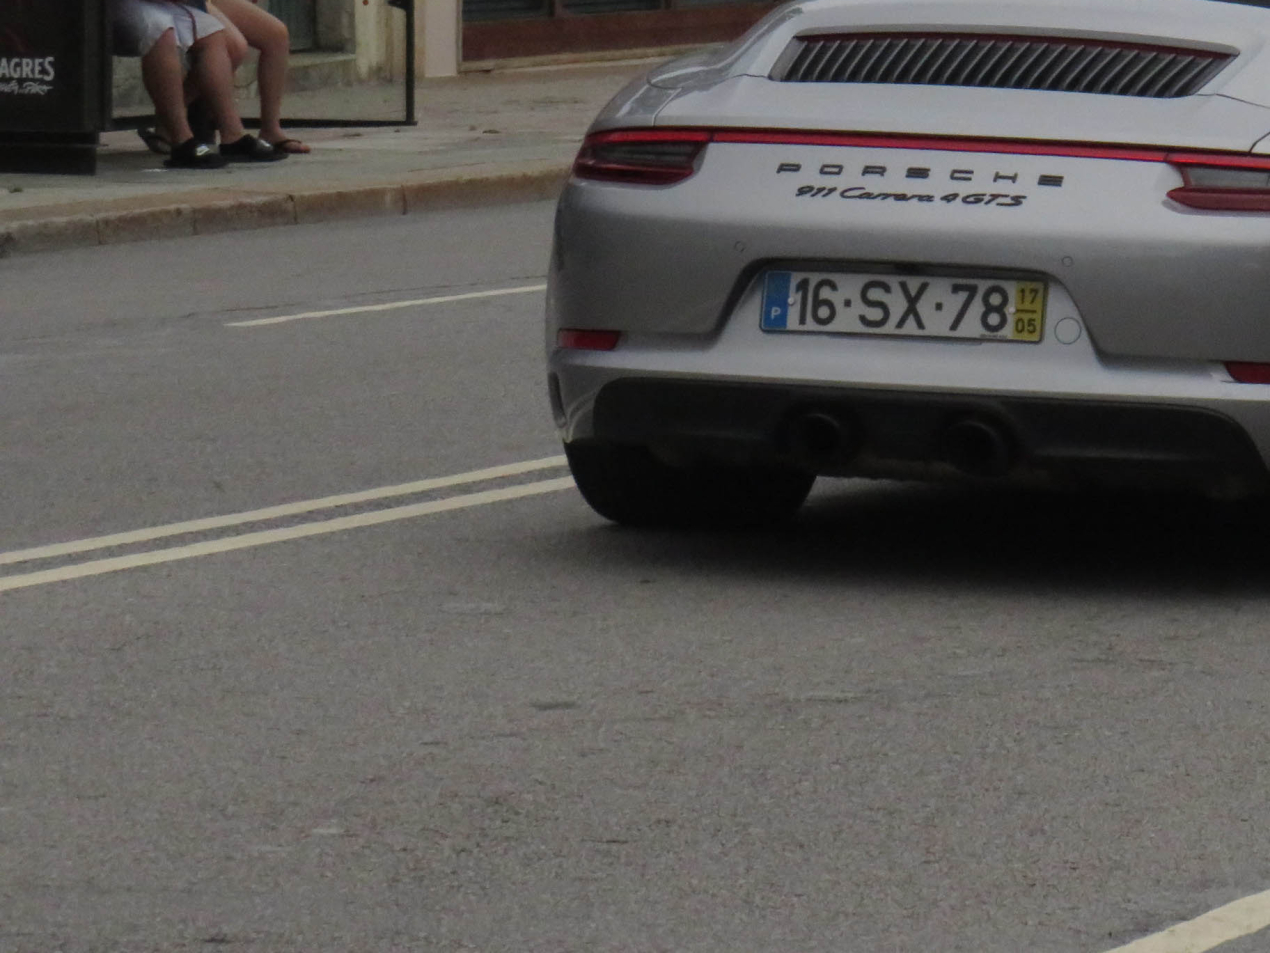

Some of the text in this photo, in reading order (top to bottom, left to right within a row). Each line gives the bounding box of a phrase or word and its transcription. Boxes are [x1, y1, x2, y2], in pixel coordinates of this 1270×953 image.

[776, 162, 1065, 187] PORSCHE
[795, 185, 839, 199] 911
[840, 186, 935, 203] Carrera
[1018, 287, 1039, 305] 17
[770, 306, 781, 319] P
[1014, 317, 1037, 334] 05
